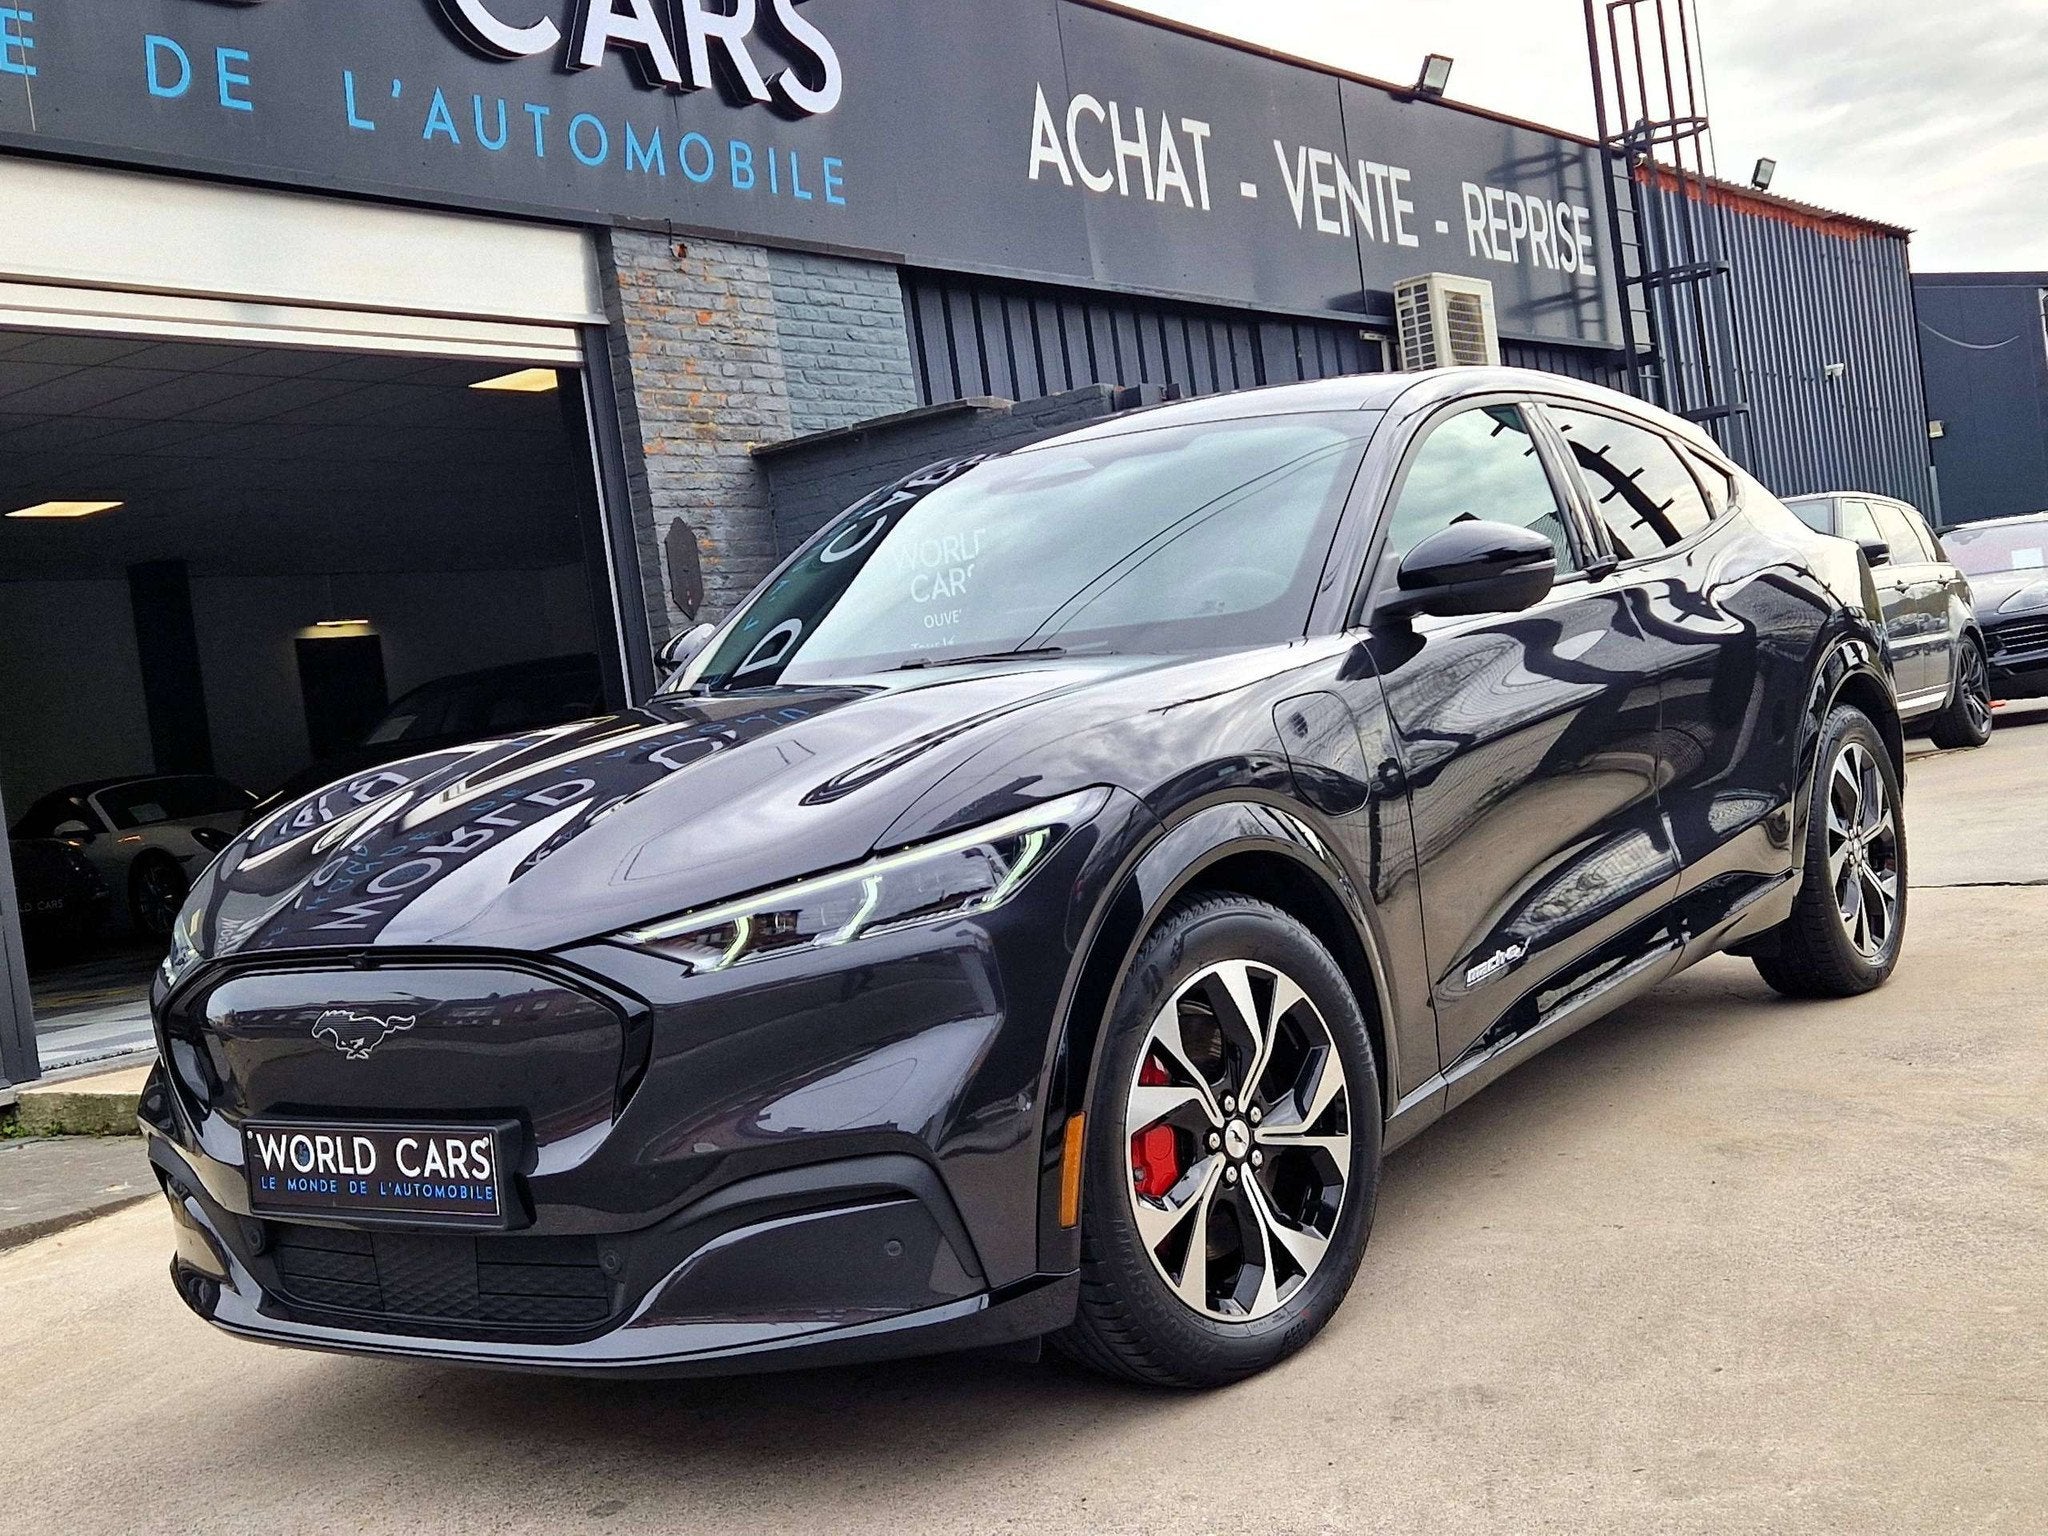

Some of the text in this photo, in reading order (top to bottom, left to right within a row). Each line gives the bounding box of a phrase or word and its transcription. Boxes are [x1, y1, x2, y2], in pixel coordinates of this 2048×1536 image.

[145, 34, 254, 111] DE
[343, 69, 846, 206] L'AUTOMOBILE
[1028, 82, 1210, 211] ACHAT
[1273, 140, 1420, 248] VENTE
[1462, 181, 1597, 276] REPRISE
[923, 608, 963, 629] OUVE
[256, 1133, 491, 1181] WORLD CARS
[261, 1176, 494, 1201] LE MONDE DE L'AUTOMOBILE
